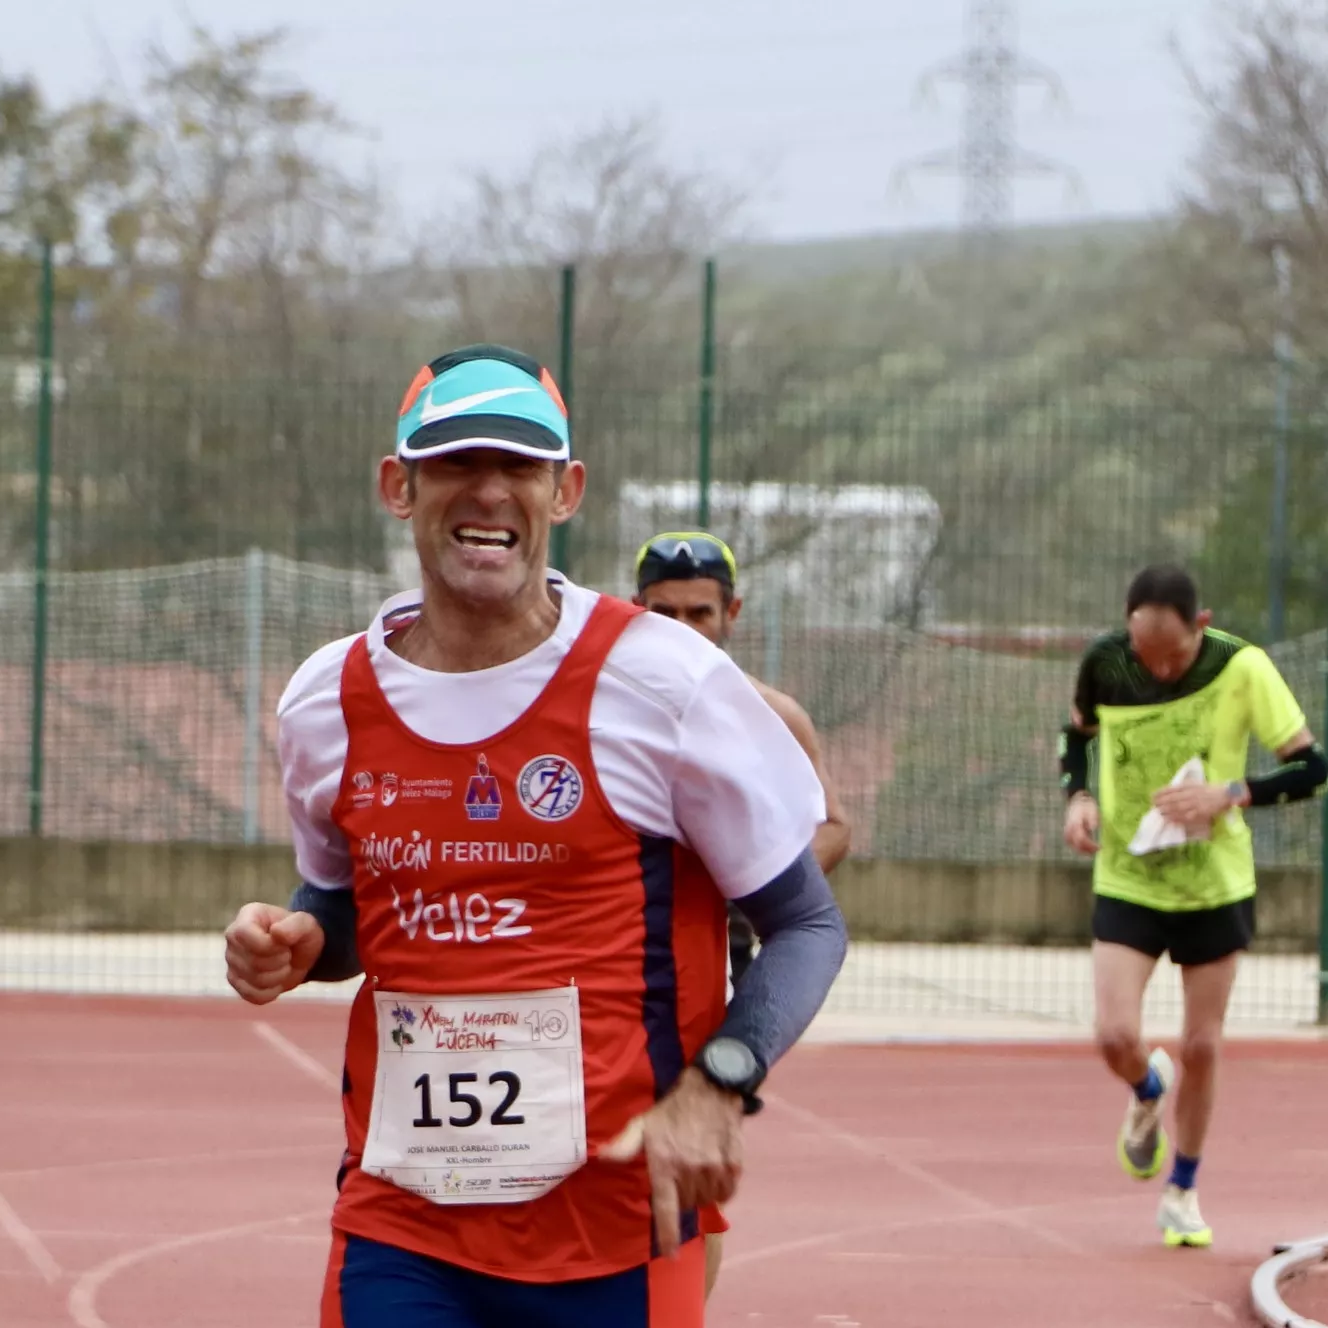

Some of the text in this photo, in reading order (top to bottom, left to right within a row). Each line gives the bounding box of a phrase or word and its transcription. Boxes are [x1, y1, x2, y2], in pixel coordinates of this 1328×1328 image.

[441, 841, 570, 863] FERTILIDAD
[435, 1030, 504, 1050] LUCENA
[413, 1070, 525, 1127] 152
[426, 1145, 460, 1153] MANUEL
[461, 1144, 500, 1153] CARBALLO
